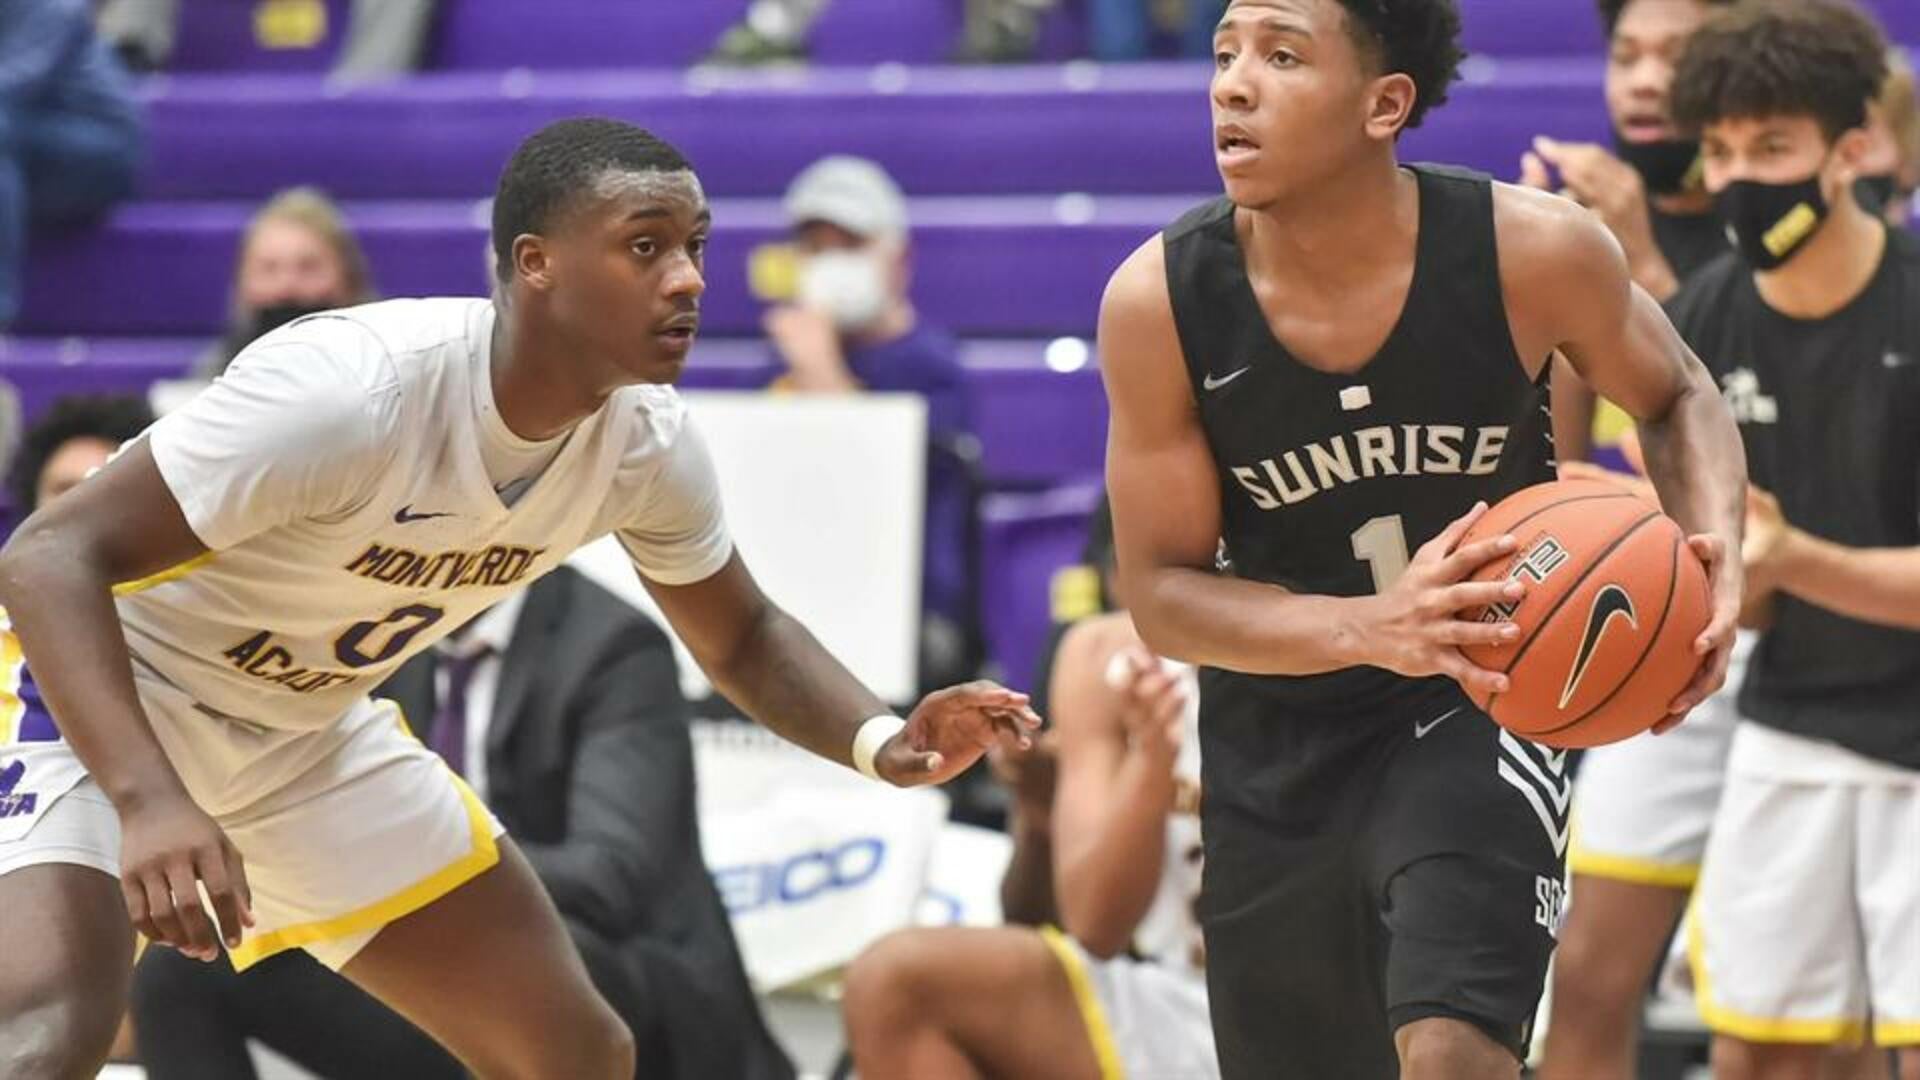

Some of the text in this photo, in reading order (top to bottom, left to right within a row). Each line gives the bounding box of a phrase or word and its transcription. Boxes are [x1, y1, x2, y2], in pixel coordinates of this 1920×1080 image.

[1231, 424, 1510, 511] SUNRISE
[1350, 513, 1410, 596] 1
[222, 629, 358, 693] ACADE
[334, 602, 444, 669] 0
[712, 836, 886, 916] EICO
